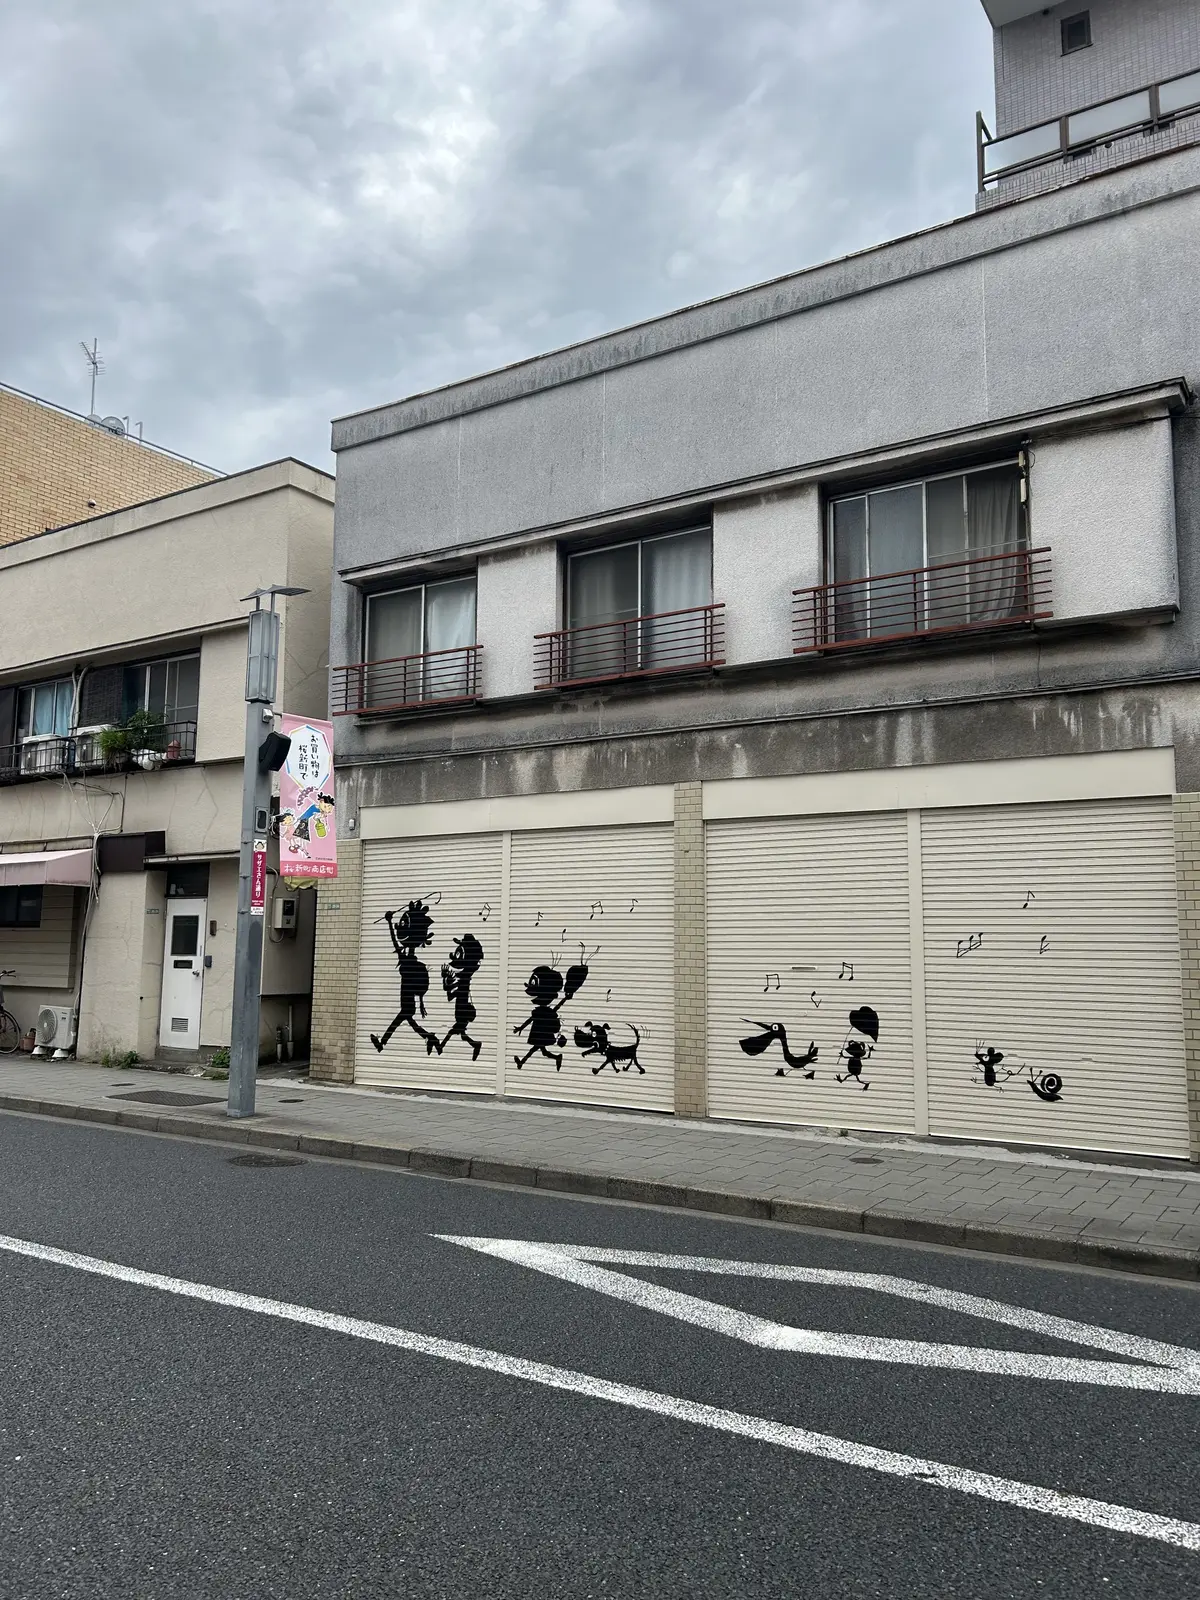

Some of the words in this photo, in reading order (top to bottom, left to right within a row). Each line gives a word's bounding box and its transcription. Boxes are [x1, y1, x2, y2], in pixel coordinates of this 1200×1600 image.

[298, 744, 308, 780] 桜新町で
[310, 734, 320, 778] お買い物は
[255, 854, 263, 898] サザエさん通り
